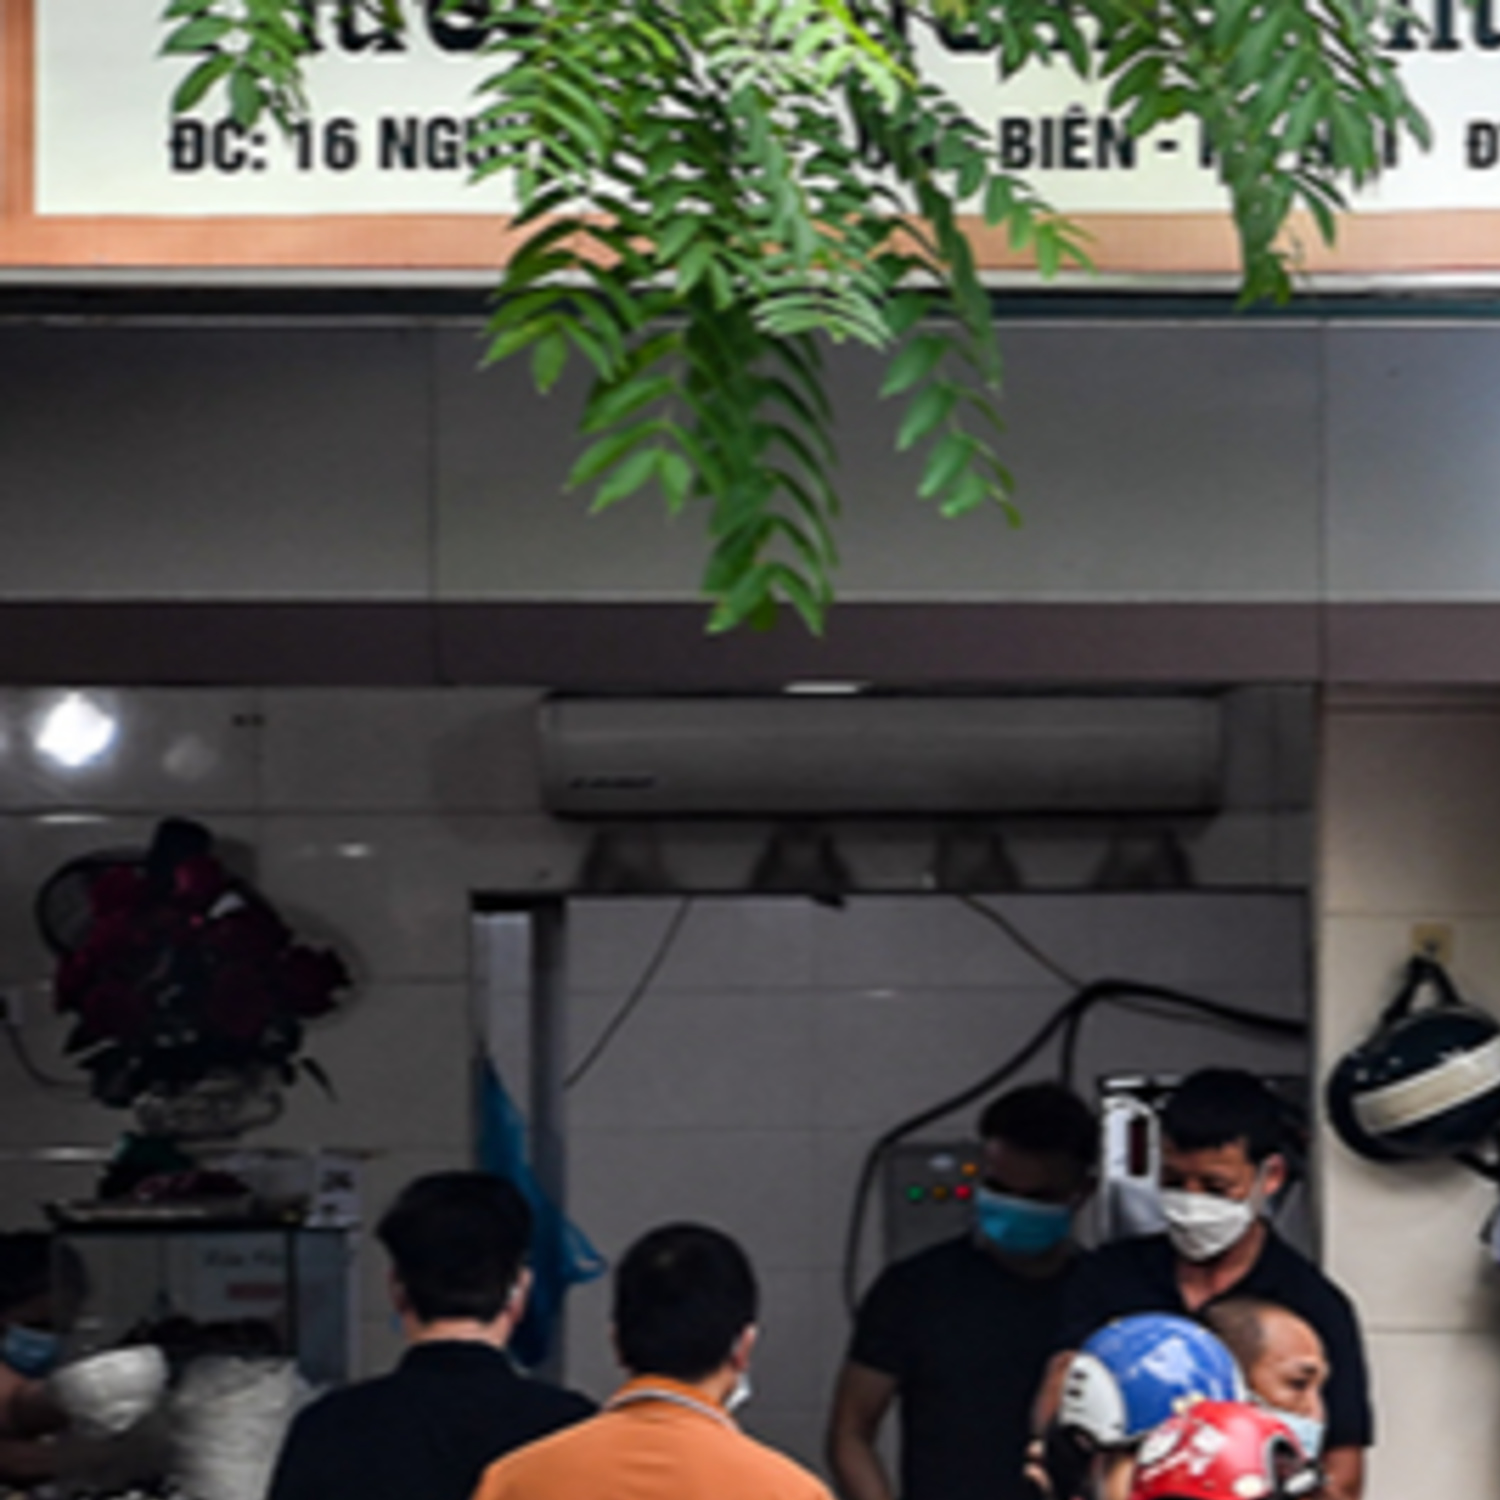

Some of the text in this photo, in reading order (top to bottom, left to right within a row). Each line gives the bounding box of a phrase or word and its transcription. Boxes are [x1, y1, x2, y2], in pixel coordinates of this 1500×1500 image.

[170, 118, 268, 172] ĐC:
[299, 117, 358, 170] 16
[1001, 107, 1136, 169] BIÊN
